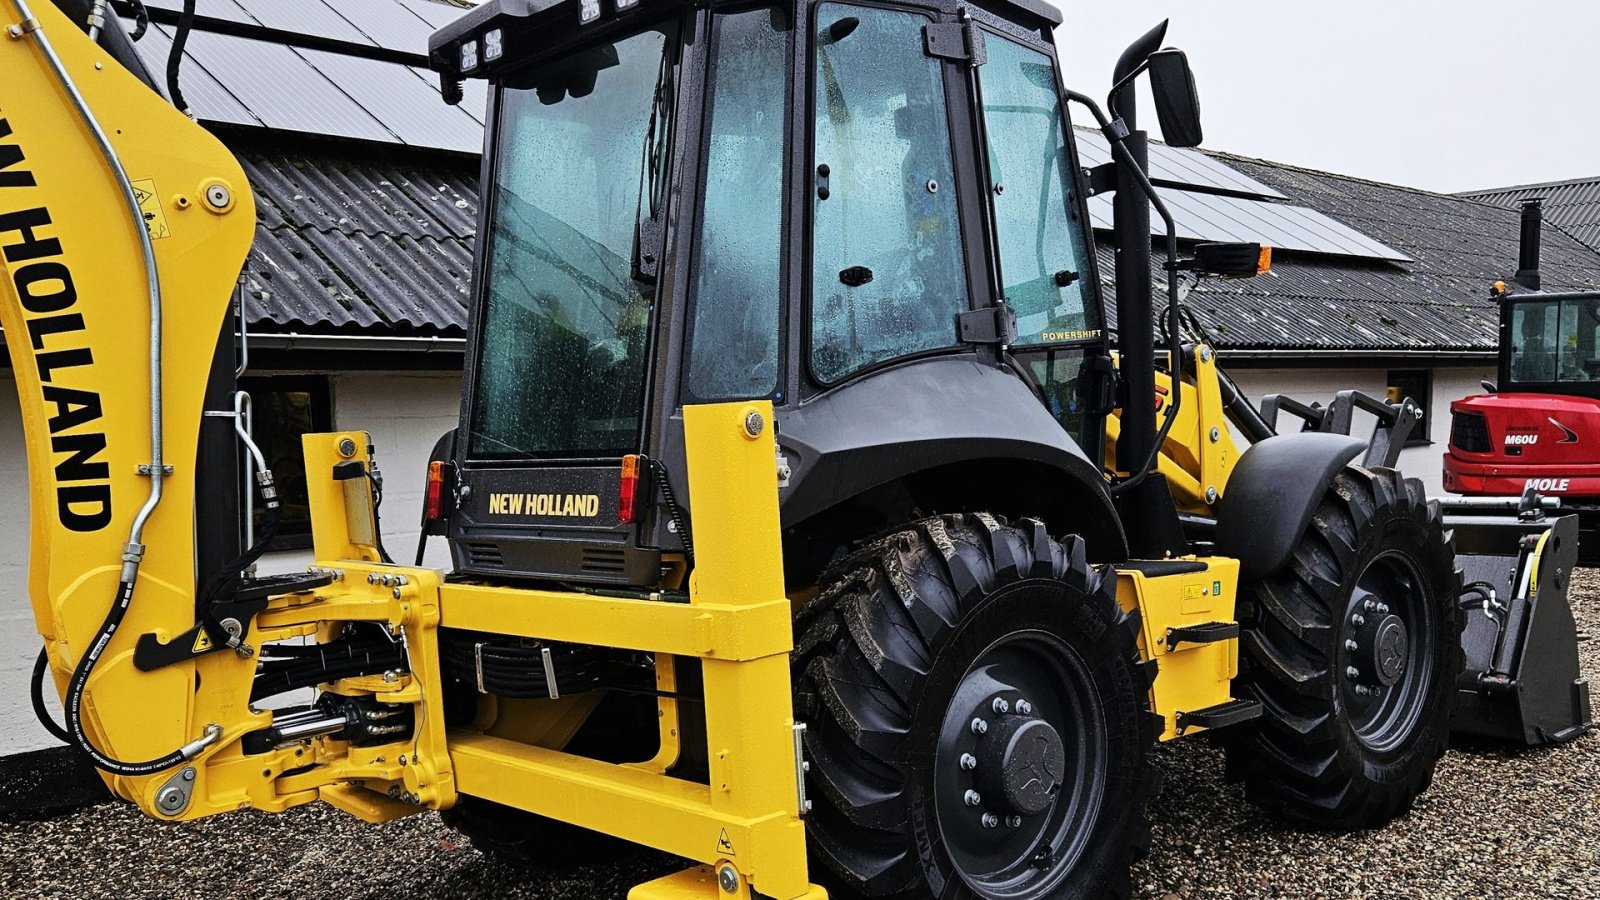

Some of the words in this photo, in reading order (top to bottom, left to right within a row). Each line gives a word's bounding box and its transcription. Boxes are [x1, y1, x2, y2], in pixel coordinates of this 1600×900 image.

[1043, 329, 1101, 341] POWERSHIFT
[0, 206, 112, 532] HOLLAND
[1504, 434, 1538, 445] M60U
[1524, 478, 1570, 491] MOLE
[489, 493, 524, 515] NEW
[525, 494, 600, 517] HOLLAND
